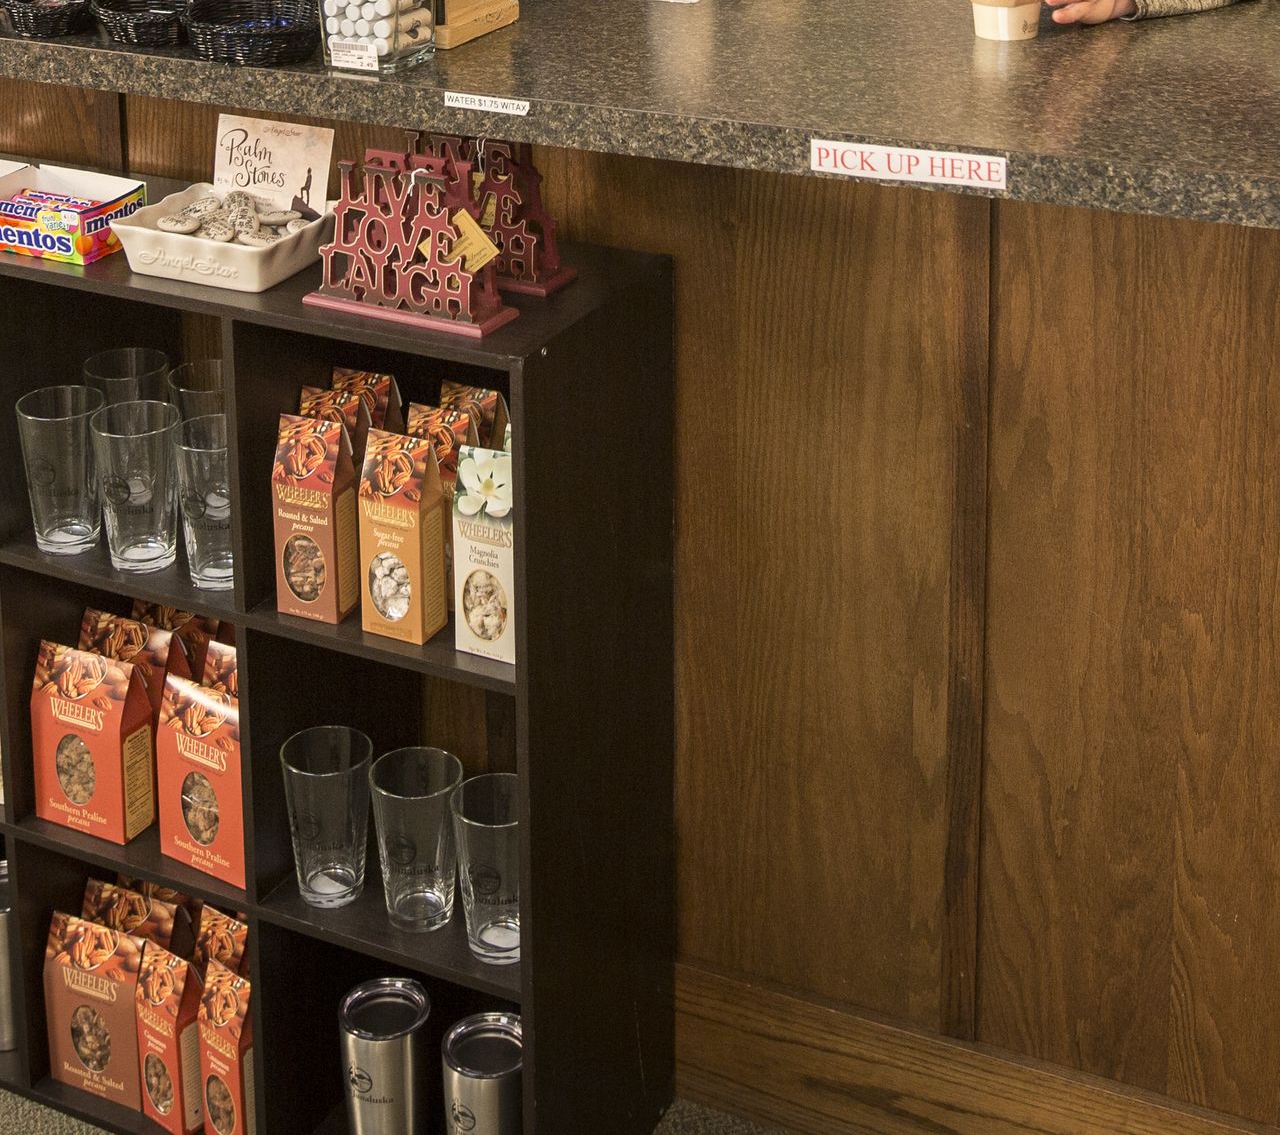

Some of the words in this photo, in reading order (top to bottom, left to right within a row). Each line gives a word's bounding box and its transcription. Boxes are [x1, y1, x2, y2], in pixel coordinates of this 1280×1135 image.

[446, 94, 477, 107] WATER
[478, 97, 500, 109] $1.75
[500, 100, 528, 113] W/TAX
[220, 128, 273, 166] Psalm
[235, 159, 286, 188] Stones
[817, 147, 878, 172] PICK
[886, 153, 920, 174] UP
[928, 157, 1002, 182] HERE
[338, 160, 448, 218] LIVE
[334, 206, 457, 269] LOVE
[319, 246, 473, 323] LAUGH
[276, 484, 330, 509] WHEELER'S
[278, 508, 301, 521] Roasted
[309, 515, 328, 526] Salted
[363, 499, 416, 529] WHEELER'S
[373, 528, 404, 544] Sugar-free
[469, 554, 499, 569] Crunchies
[470, 545, 499, 560] Magnolia
[50, 697, 103, 732] WHEELER'S
[176, 731, 227, 772] WHEELER'S
[49, 797, 80, 819] Southern
[82, 807, 108, 826] Praline
[67, 815, 91, 828] pecans
[173, 835, 203, 857] Southern
[205, 847, 230, 869] Praline
[62, 965, 118, 1002] WHEELER'S
